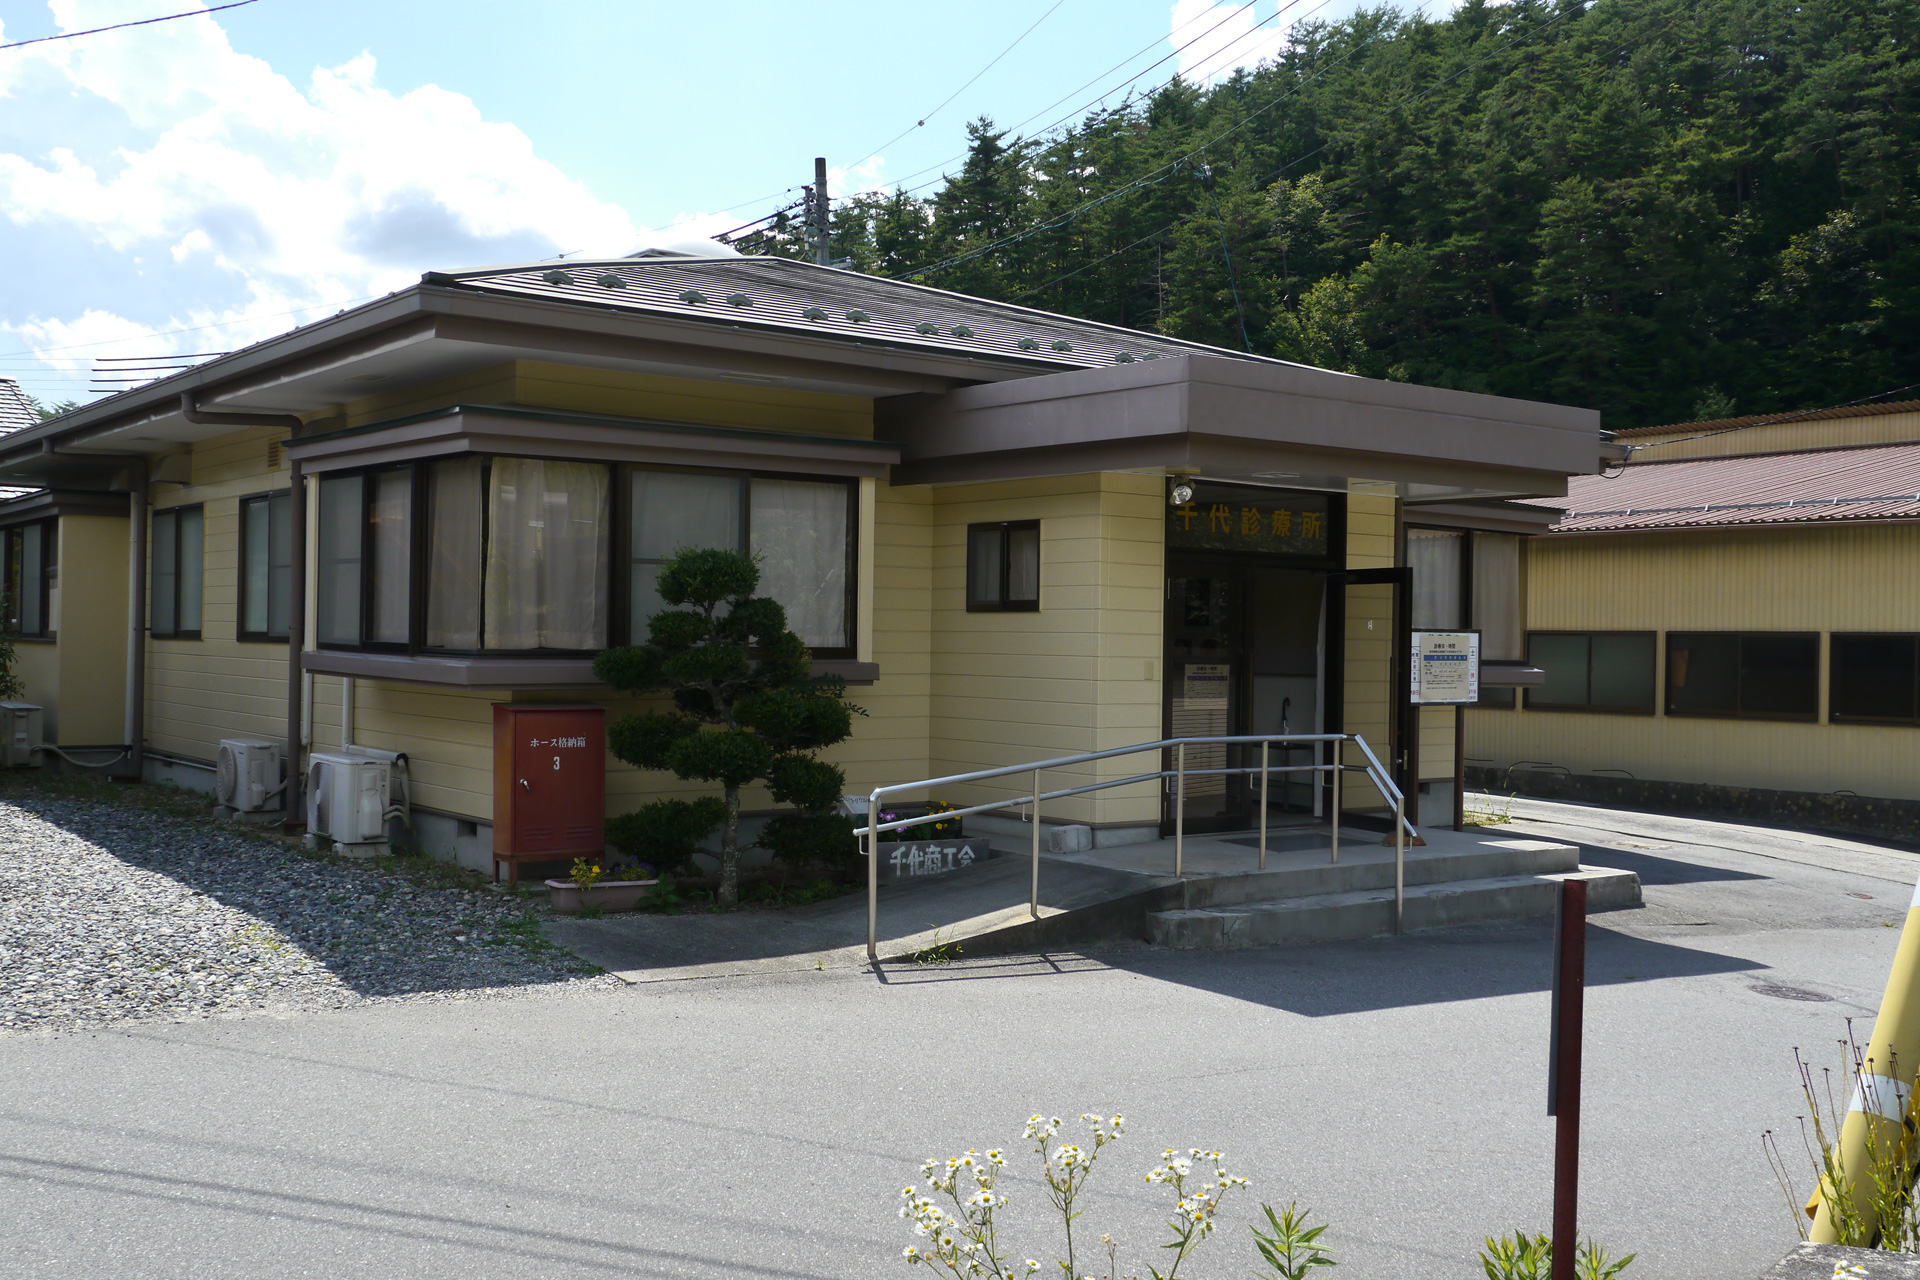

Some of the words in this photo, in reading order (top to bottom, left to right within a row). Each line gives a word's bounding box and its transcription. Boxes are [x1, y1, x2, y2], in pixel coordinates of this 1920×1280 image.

[1176, 501, 1321, 539] 千代診療所
[530, 737, 586, 748] ホース格納箱
[553, 756, 560, 770] 3
[889, 844, 976, 877] 千代商工会
